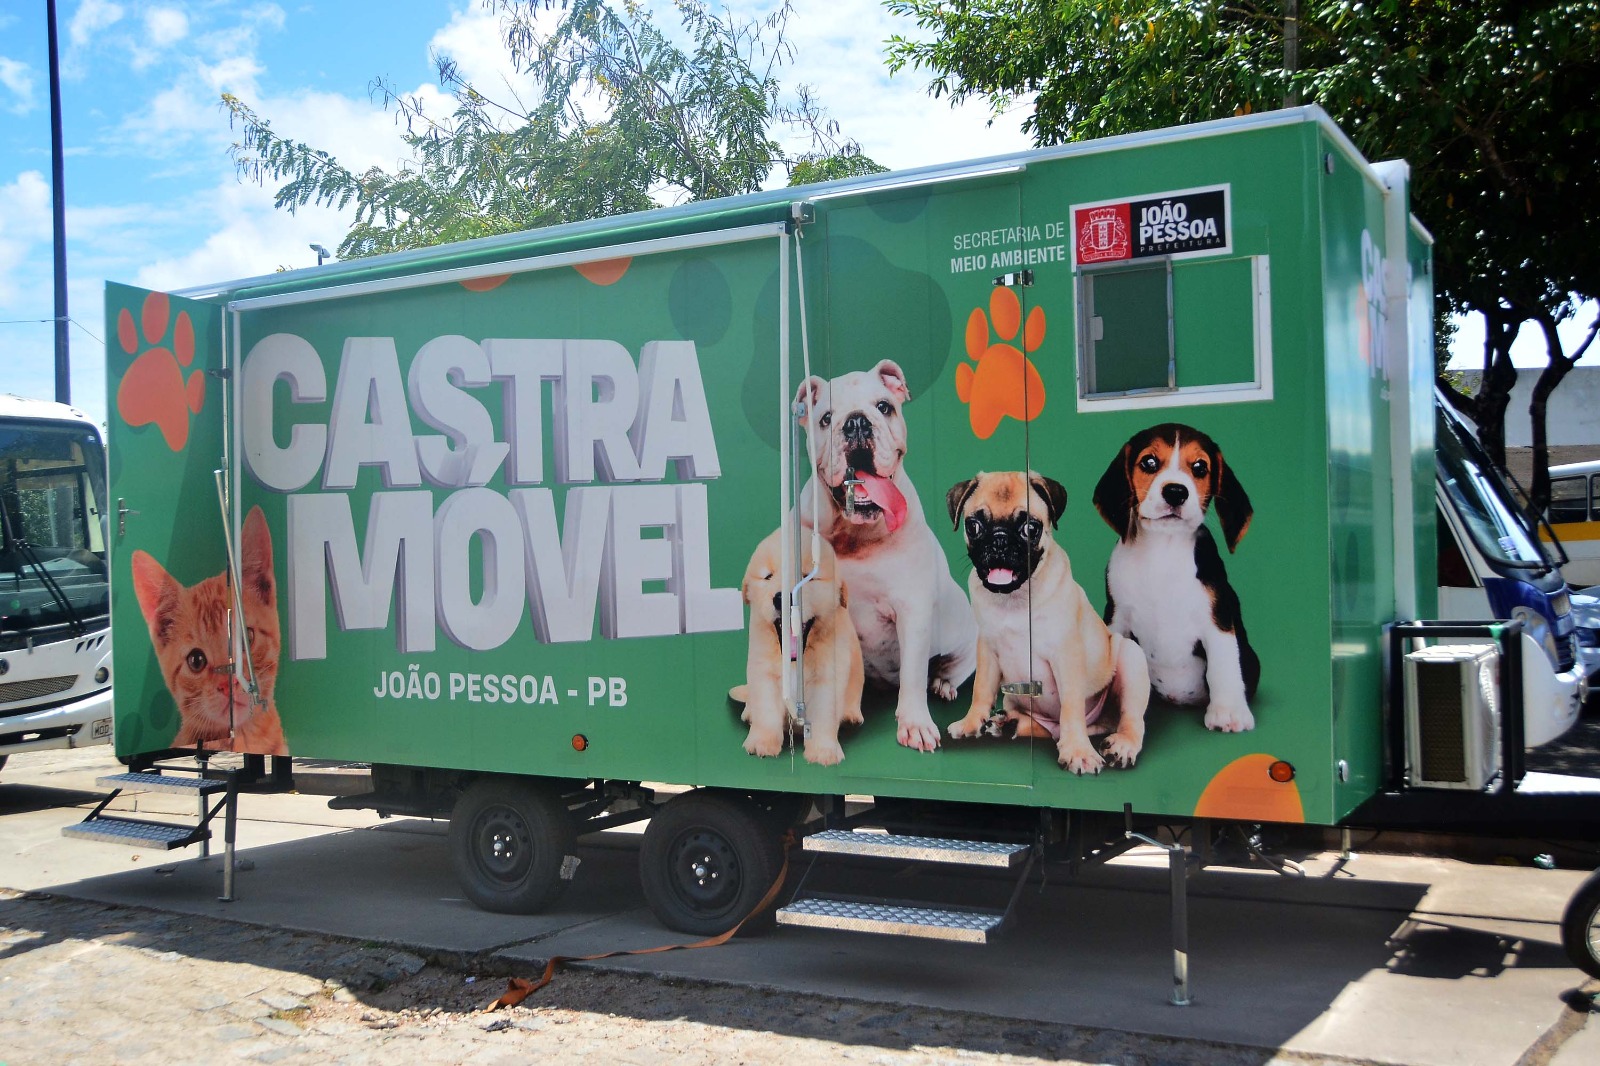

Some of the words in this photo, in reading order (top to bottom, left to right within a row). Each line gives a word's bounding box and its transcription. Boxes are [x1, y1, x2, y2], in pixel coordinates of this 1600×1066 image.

[1139, 200, 1187, 227] JOÃO
[953, 225, 1041, 251] SECRETARIA
[1045, 221, 1065, 240] DE
[1140, 217, 1218, 245] PESSOA
[1140, 237, 1220, 253] PREFEITURA
[950, 254, 987, 274] MEIO
[990, 244, 1066, 269] AMBIENTE
[240, 332, 722, 492] CASTRA
[373, 663, 441, 700] JOÃO
[449, 672, 559, 705] PESSOA
[588, 676, 628, 707] PB
